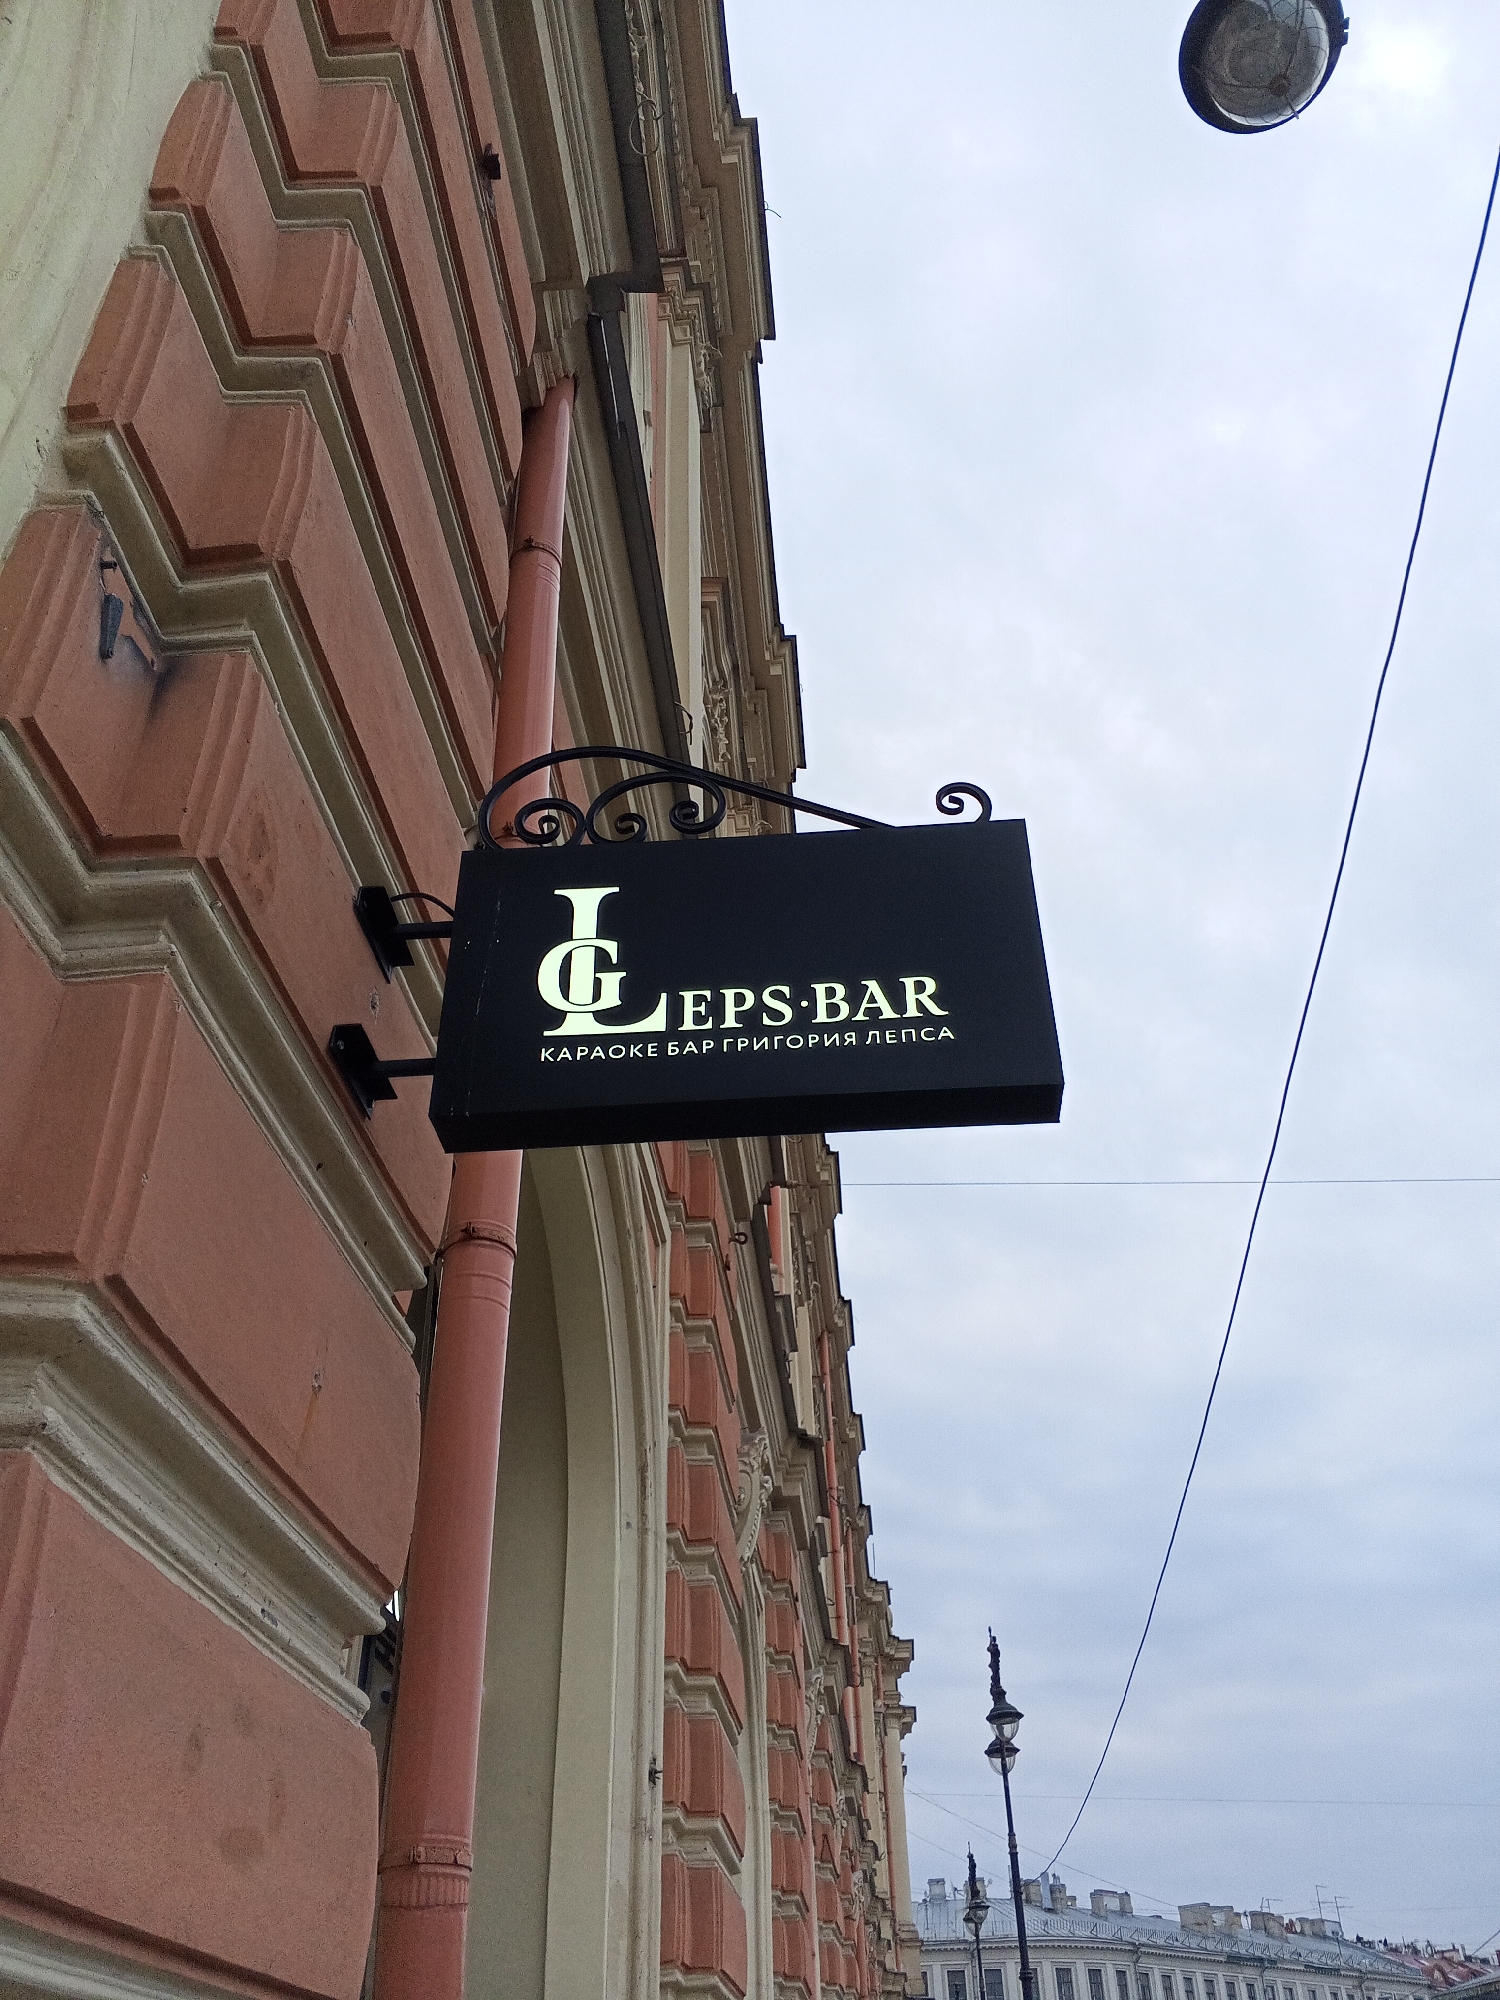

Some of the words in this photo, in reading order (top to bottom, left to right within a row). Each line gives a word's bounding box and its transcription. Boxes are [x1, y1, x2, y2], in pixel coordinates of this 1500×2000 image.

[540, 1042, 659, 1062] КАРАОКЕ
[667, 1039, 715, 1056] БАР
[723, 1031, 857, 1053] ГРИГОРИЯ
[865, 1026, 955, 1044] ЛЕПСА
